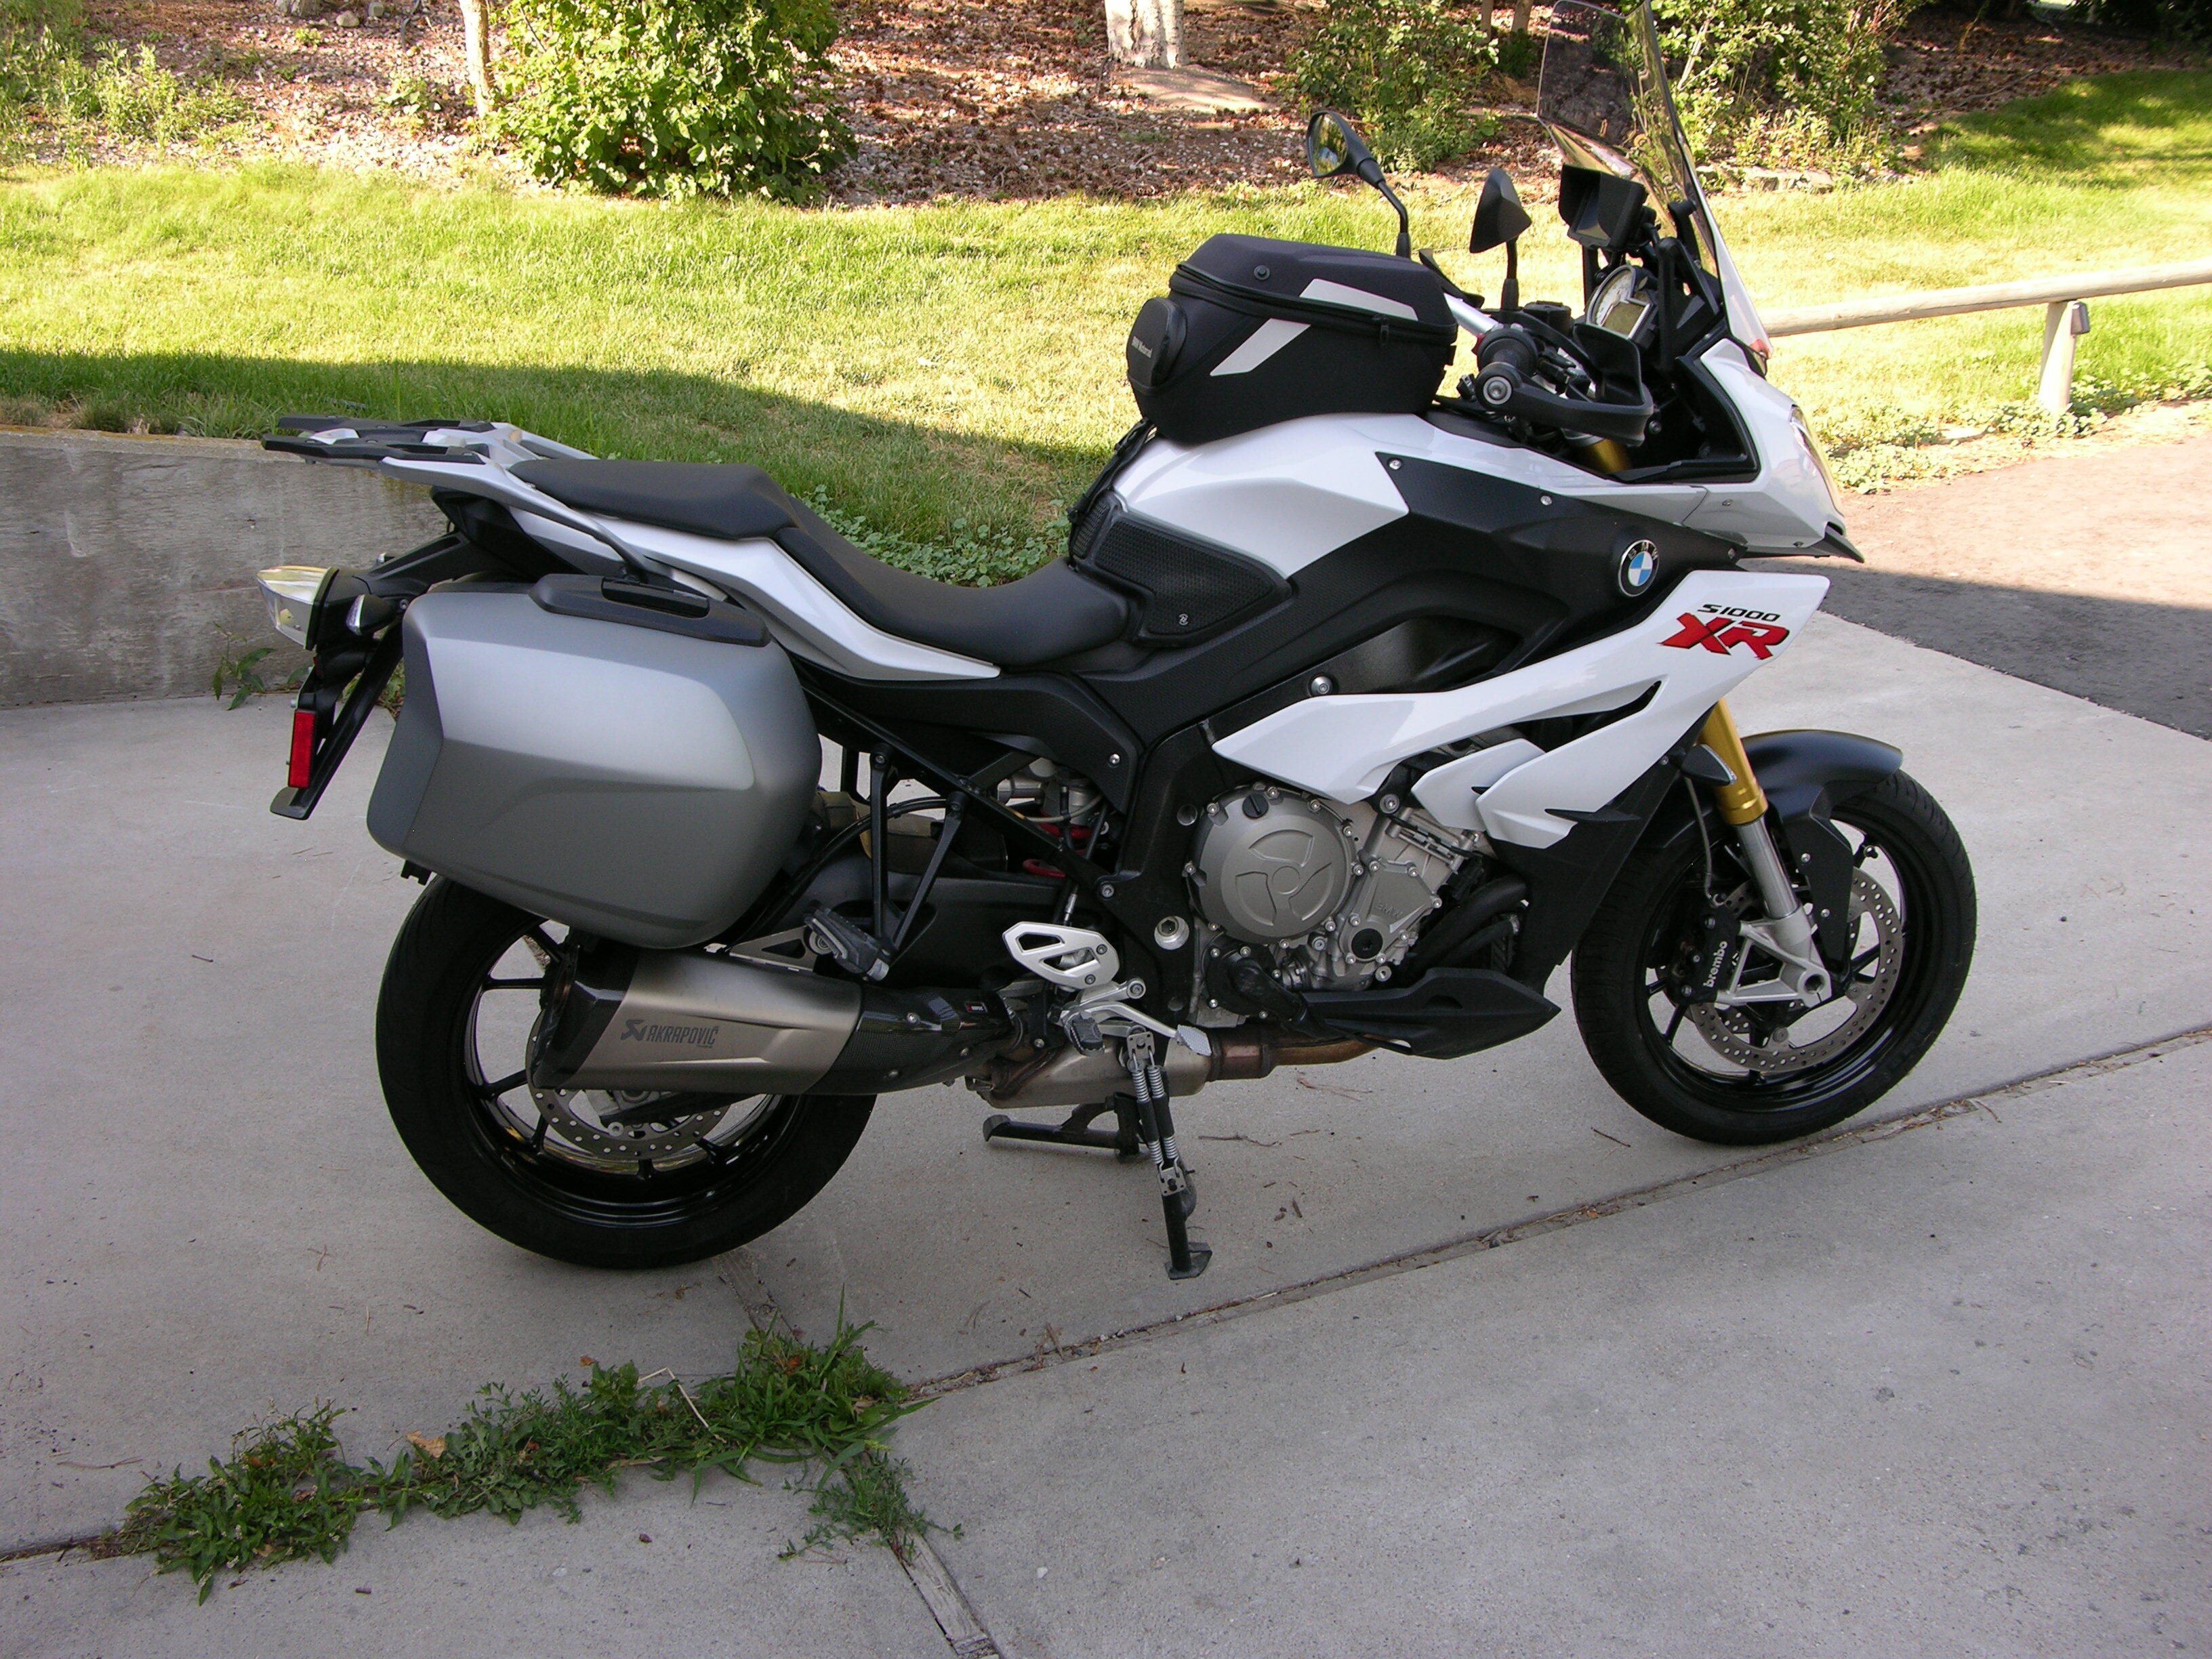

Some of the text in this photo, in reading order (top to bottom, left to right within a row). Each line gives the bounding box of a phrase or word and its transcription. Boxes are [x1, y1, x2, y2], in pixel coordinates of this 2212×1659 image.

[1628, 542, 1658, 560] BMW
[1697, 604, 1781, 621] S1000
[1656, 613, 1790, 659] XR
[1702, 941, 1728, 987] brembo
